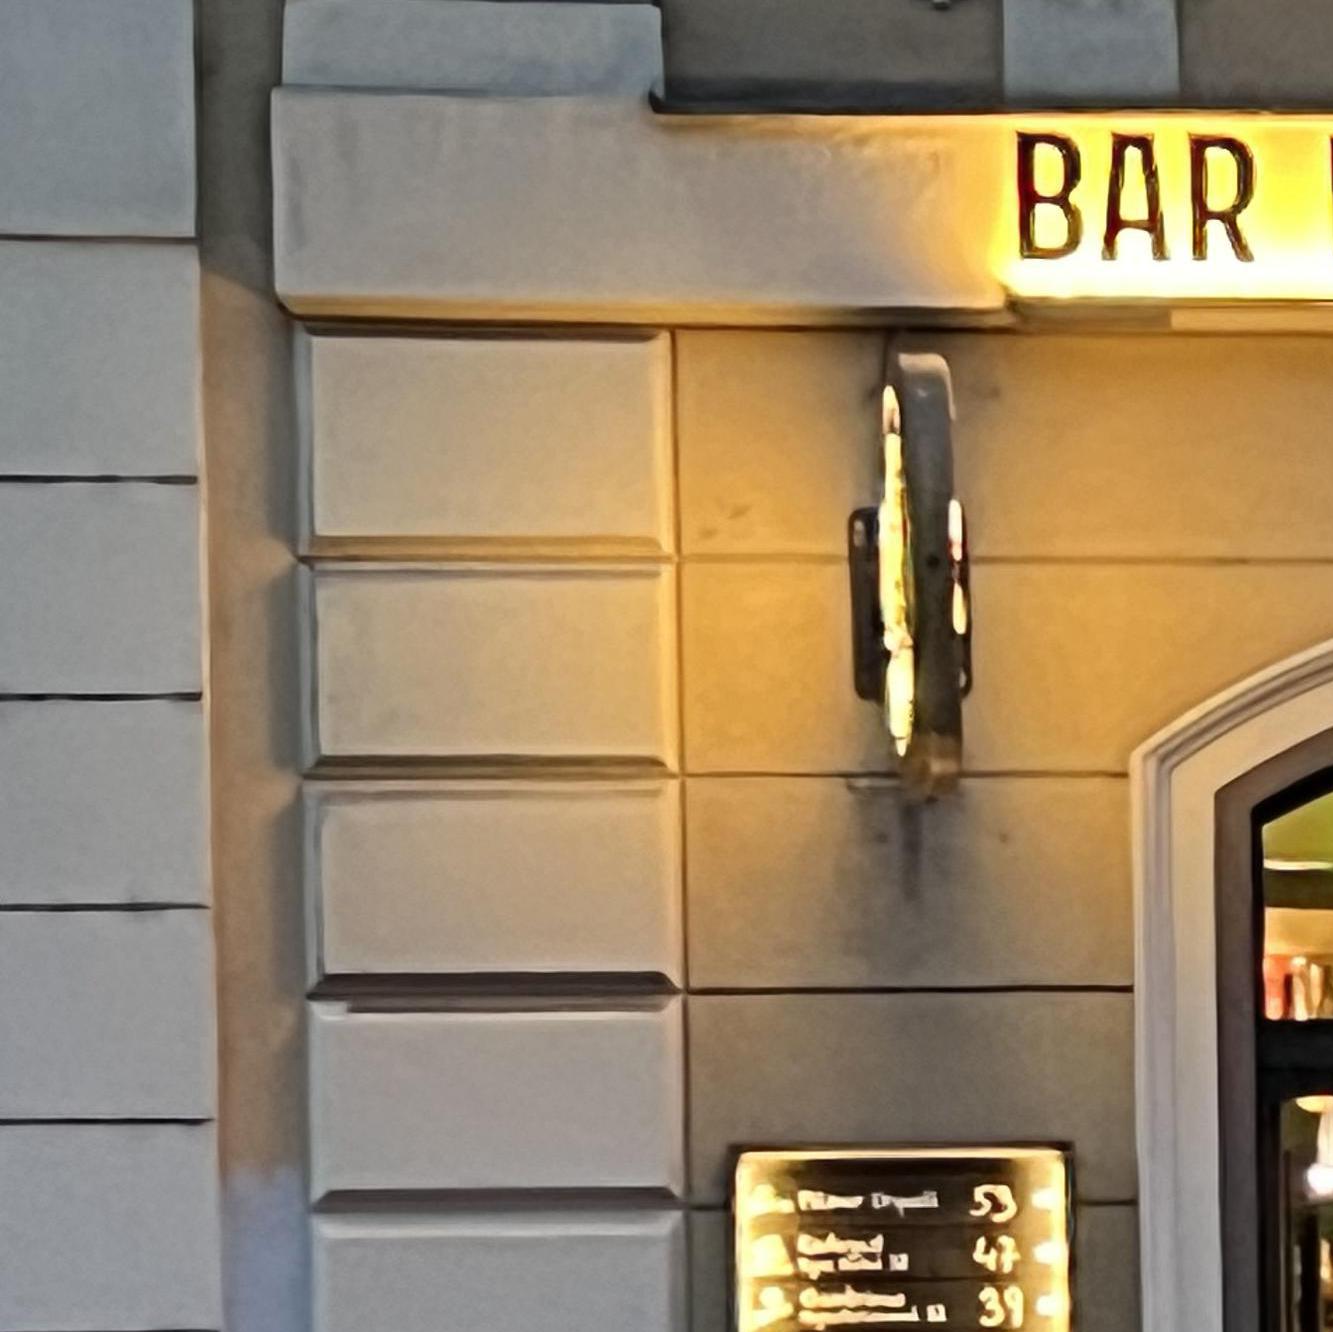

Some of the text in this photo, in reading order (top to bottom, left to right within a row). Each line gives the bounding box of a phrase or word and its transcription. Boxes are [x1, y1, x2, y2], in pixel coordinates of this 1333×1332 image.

[1016, 131, 1256, 262] BAR
[972, 1235, 1022, 1274] 47
[978, 1286, 1025, 1328] 39
